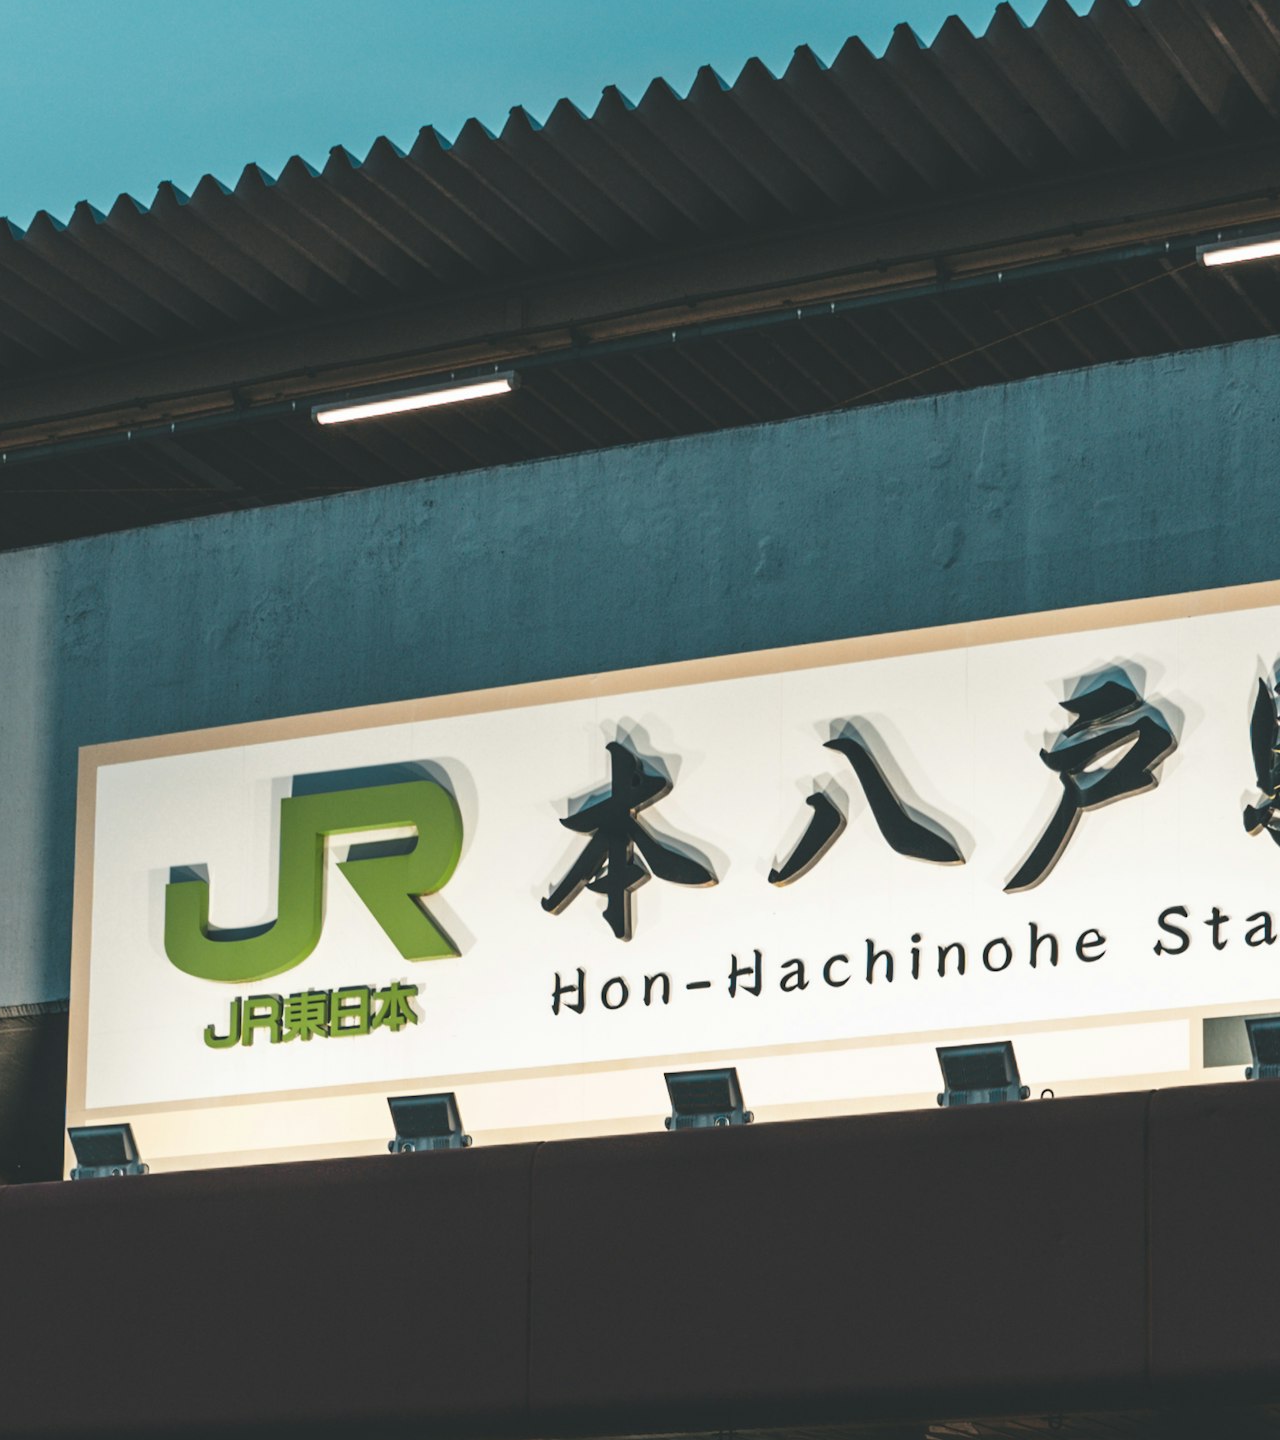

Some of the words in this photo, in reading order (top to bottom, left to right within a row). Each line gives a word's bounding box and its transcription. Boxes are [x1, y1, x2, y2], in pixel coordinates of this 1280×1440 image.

[164, 759, 464, 983] JR
[203, 981, 419, 1049] JR東日本
[550, 921, 1108, 1017] Hon-Hachinohe
